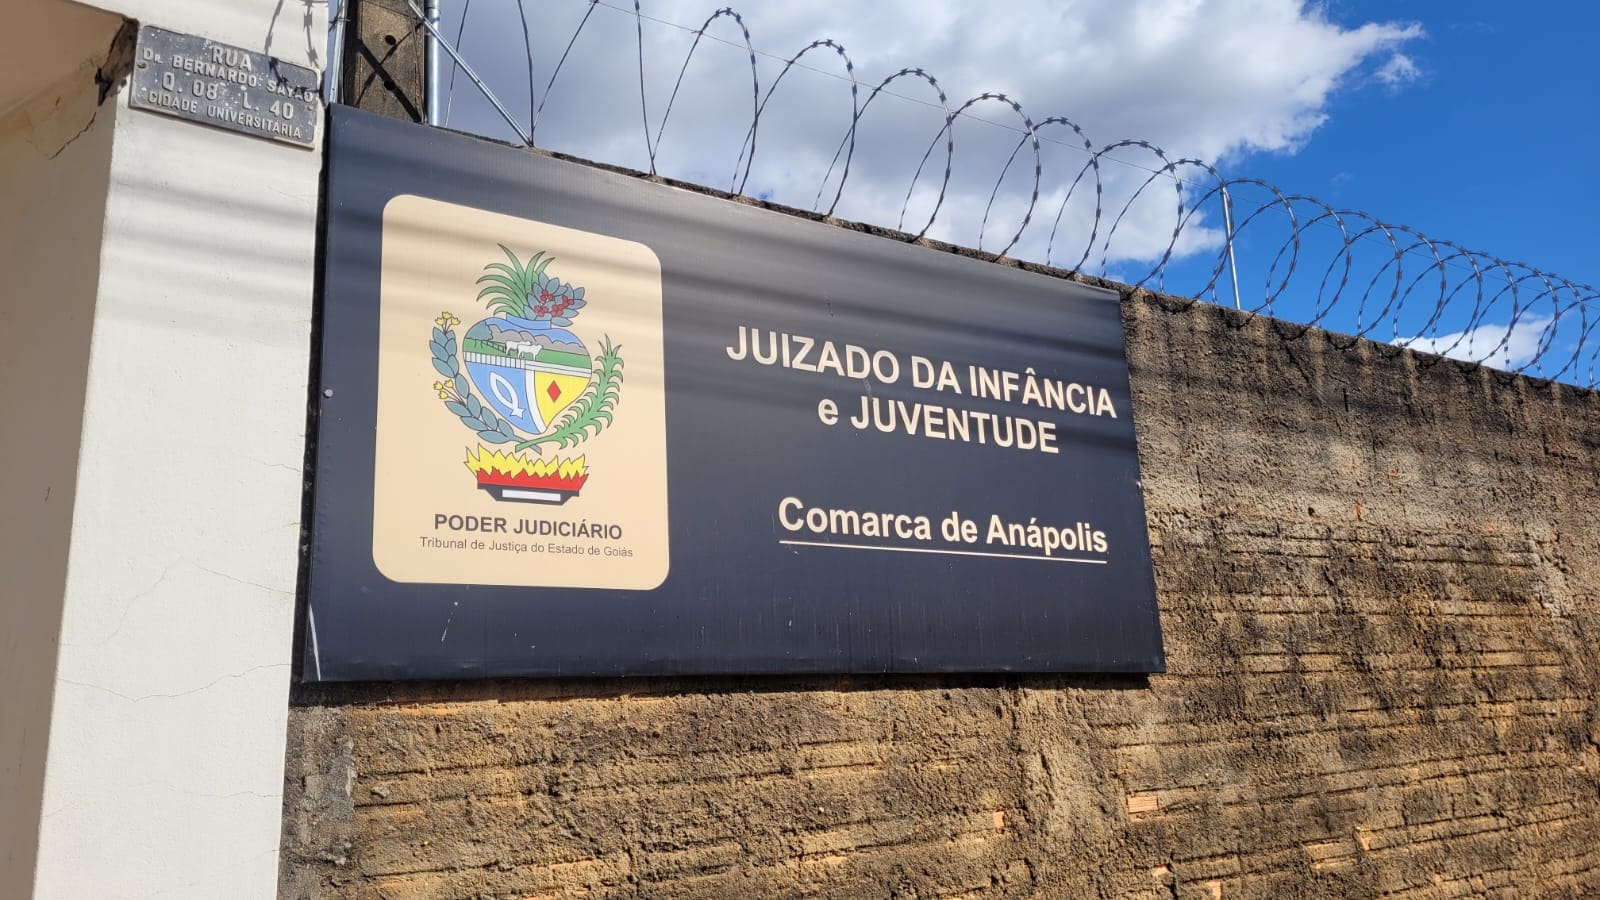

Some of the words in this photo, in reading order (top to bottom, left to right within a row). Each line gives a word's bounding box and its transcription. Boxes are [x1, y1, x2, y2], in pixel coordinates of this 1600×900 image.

[172, 55, 257, 87] BERNARDO
[211, 44, 252, 71] RUA
[148, 91, 198, 113] CIDADE
[207, 105, 302, 138] UNIVERSITÁRIA
[192, 80, 217, 100] 08
[269, 100, 294, 120] 40
[726, 326, 900, 384] JUIZADO
[911, 355, 961, 394] DA
[969, 367, 1117, 418] INFÂNCIA
[818, 398, 838, 425] e
[851, 396, 1060, 454] JUVENTUDE
[434, 513, 507, 533] PODER
[513, 519, 622, 540] JUDICIÁRIO
[778, 497, 931, 540] Comarca
[941, 511, 978, 543] de
[986, 514, 1108, 555] Anápolis
[420, 536, 467, 549] Tribunal
[470, 539, 485, 550] de
[488, 540, 528, 554] Justiça
[531, 542, 545, 553] do
[548, 543, 585, 555] Estado
[587, 545, 601, 556] de
[603, 546, 633, 558] Goiás
